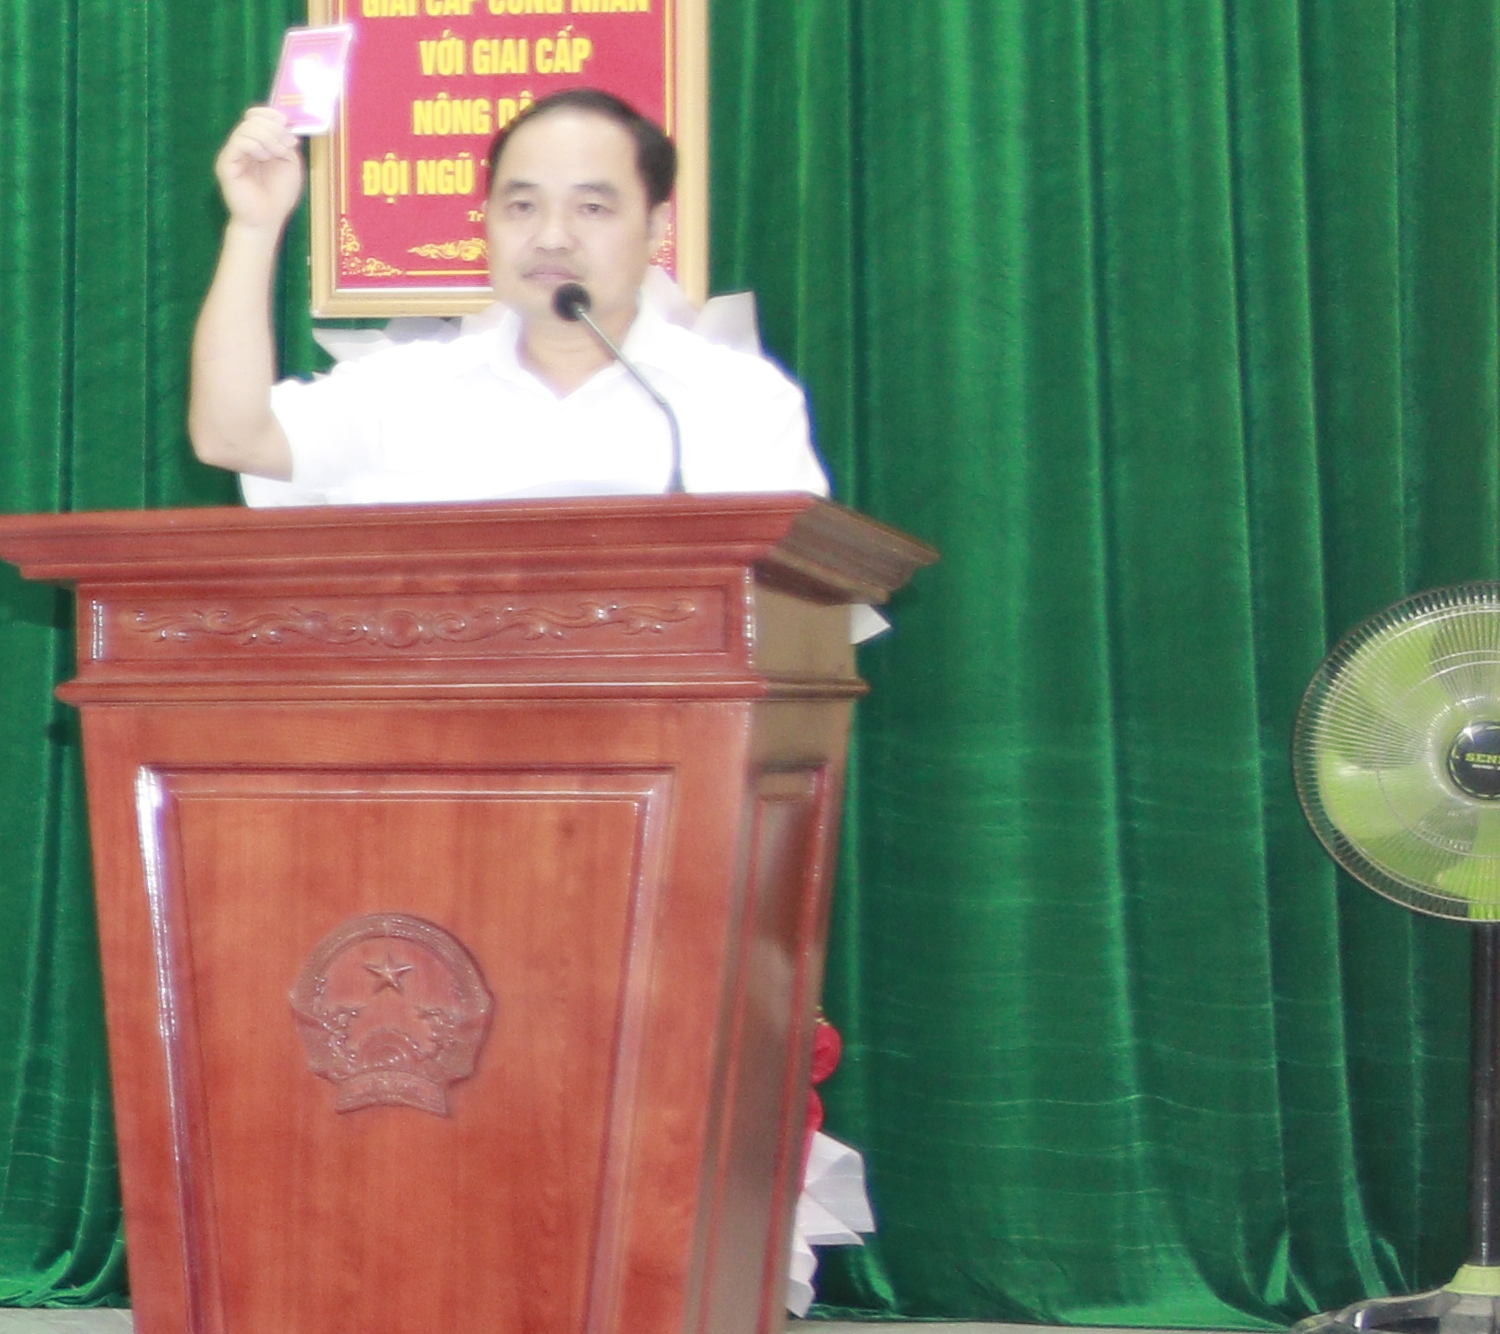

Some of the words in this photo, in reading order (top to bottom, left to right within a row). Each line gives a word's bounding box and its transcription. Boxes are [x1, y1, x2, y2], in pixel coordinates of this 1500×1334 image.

[419, 30, 467, 76] VỚI
[471, 37, 530, 75] GIAI
[533, 25, 593, 74] CẤP
[412, 92, 493, 136] NÔNG
[361, 152, 412, 203] ĐỘI
[415, 152, 476, 195] NGŨ
